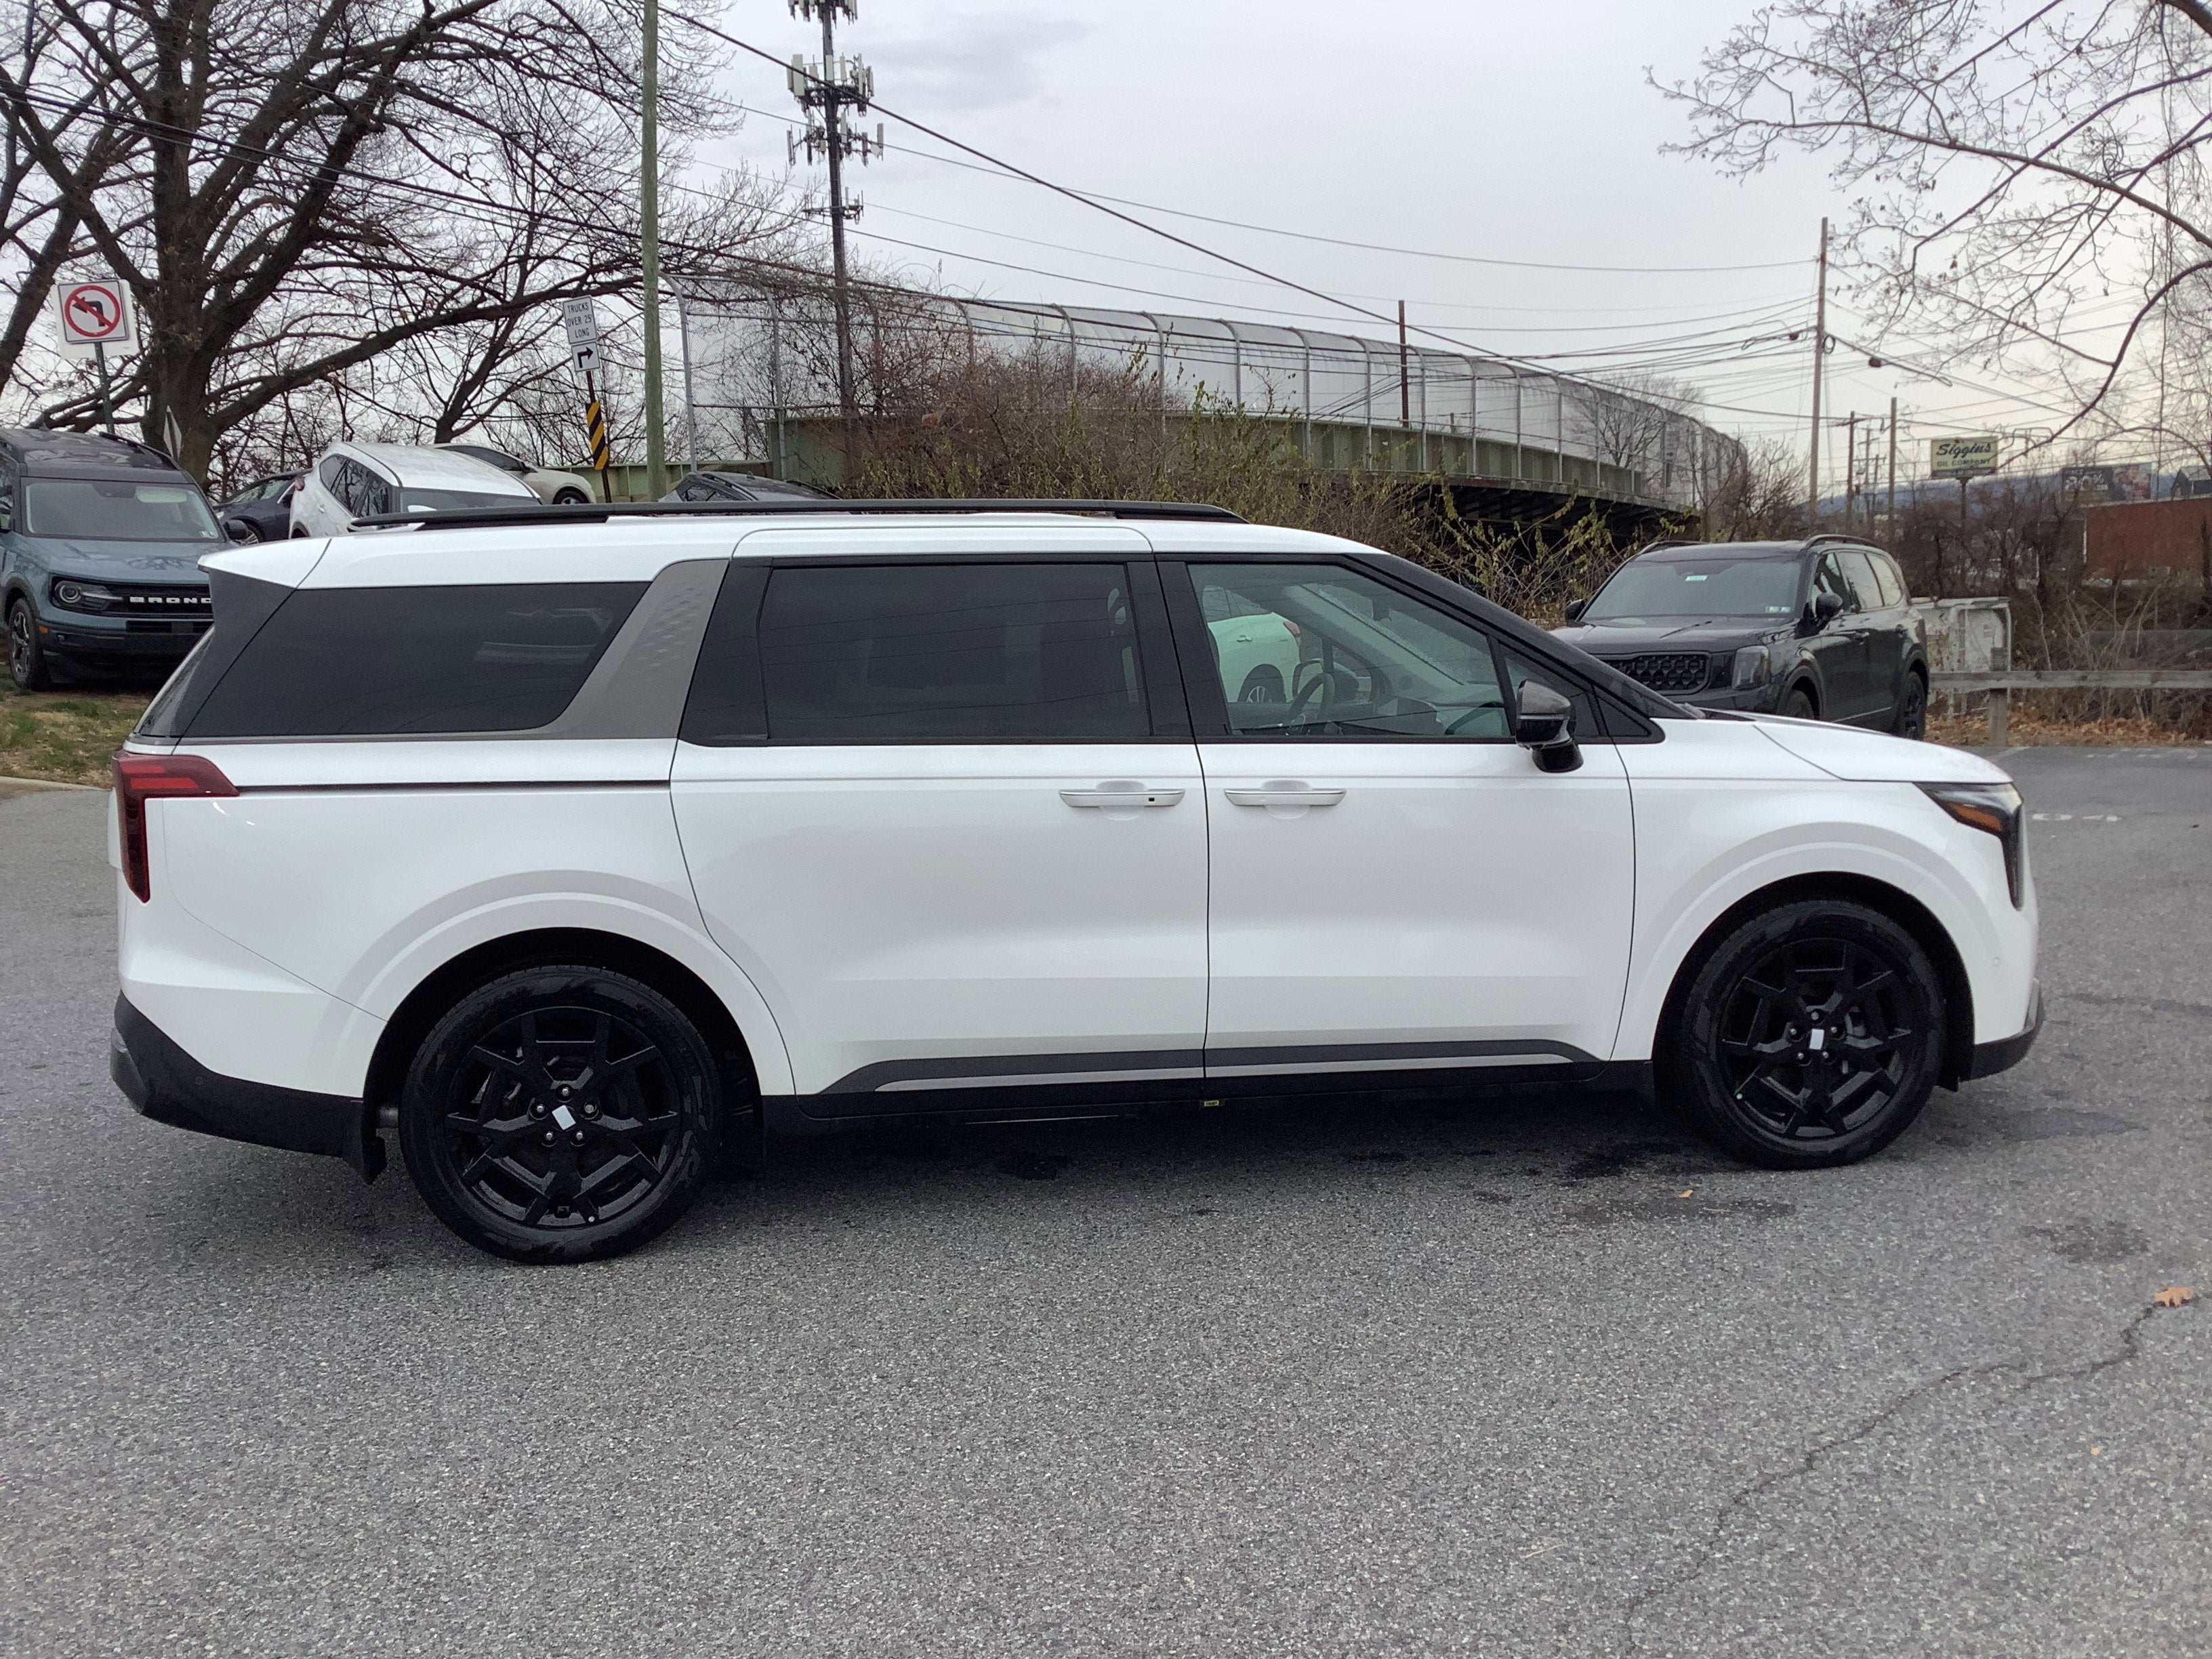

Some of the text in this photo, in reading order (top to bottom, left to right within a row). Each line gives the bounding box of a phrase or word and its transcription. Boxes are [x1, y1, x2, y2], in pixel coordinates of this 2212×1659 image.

[567, 302, 589, 314] TRUCKS
[567, 316, 581, 327] OVER
[575, 328, 590, 337] LONG
